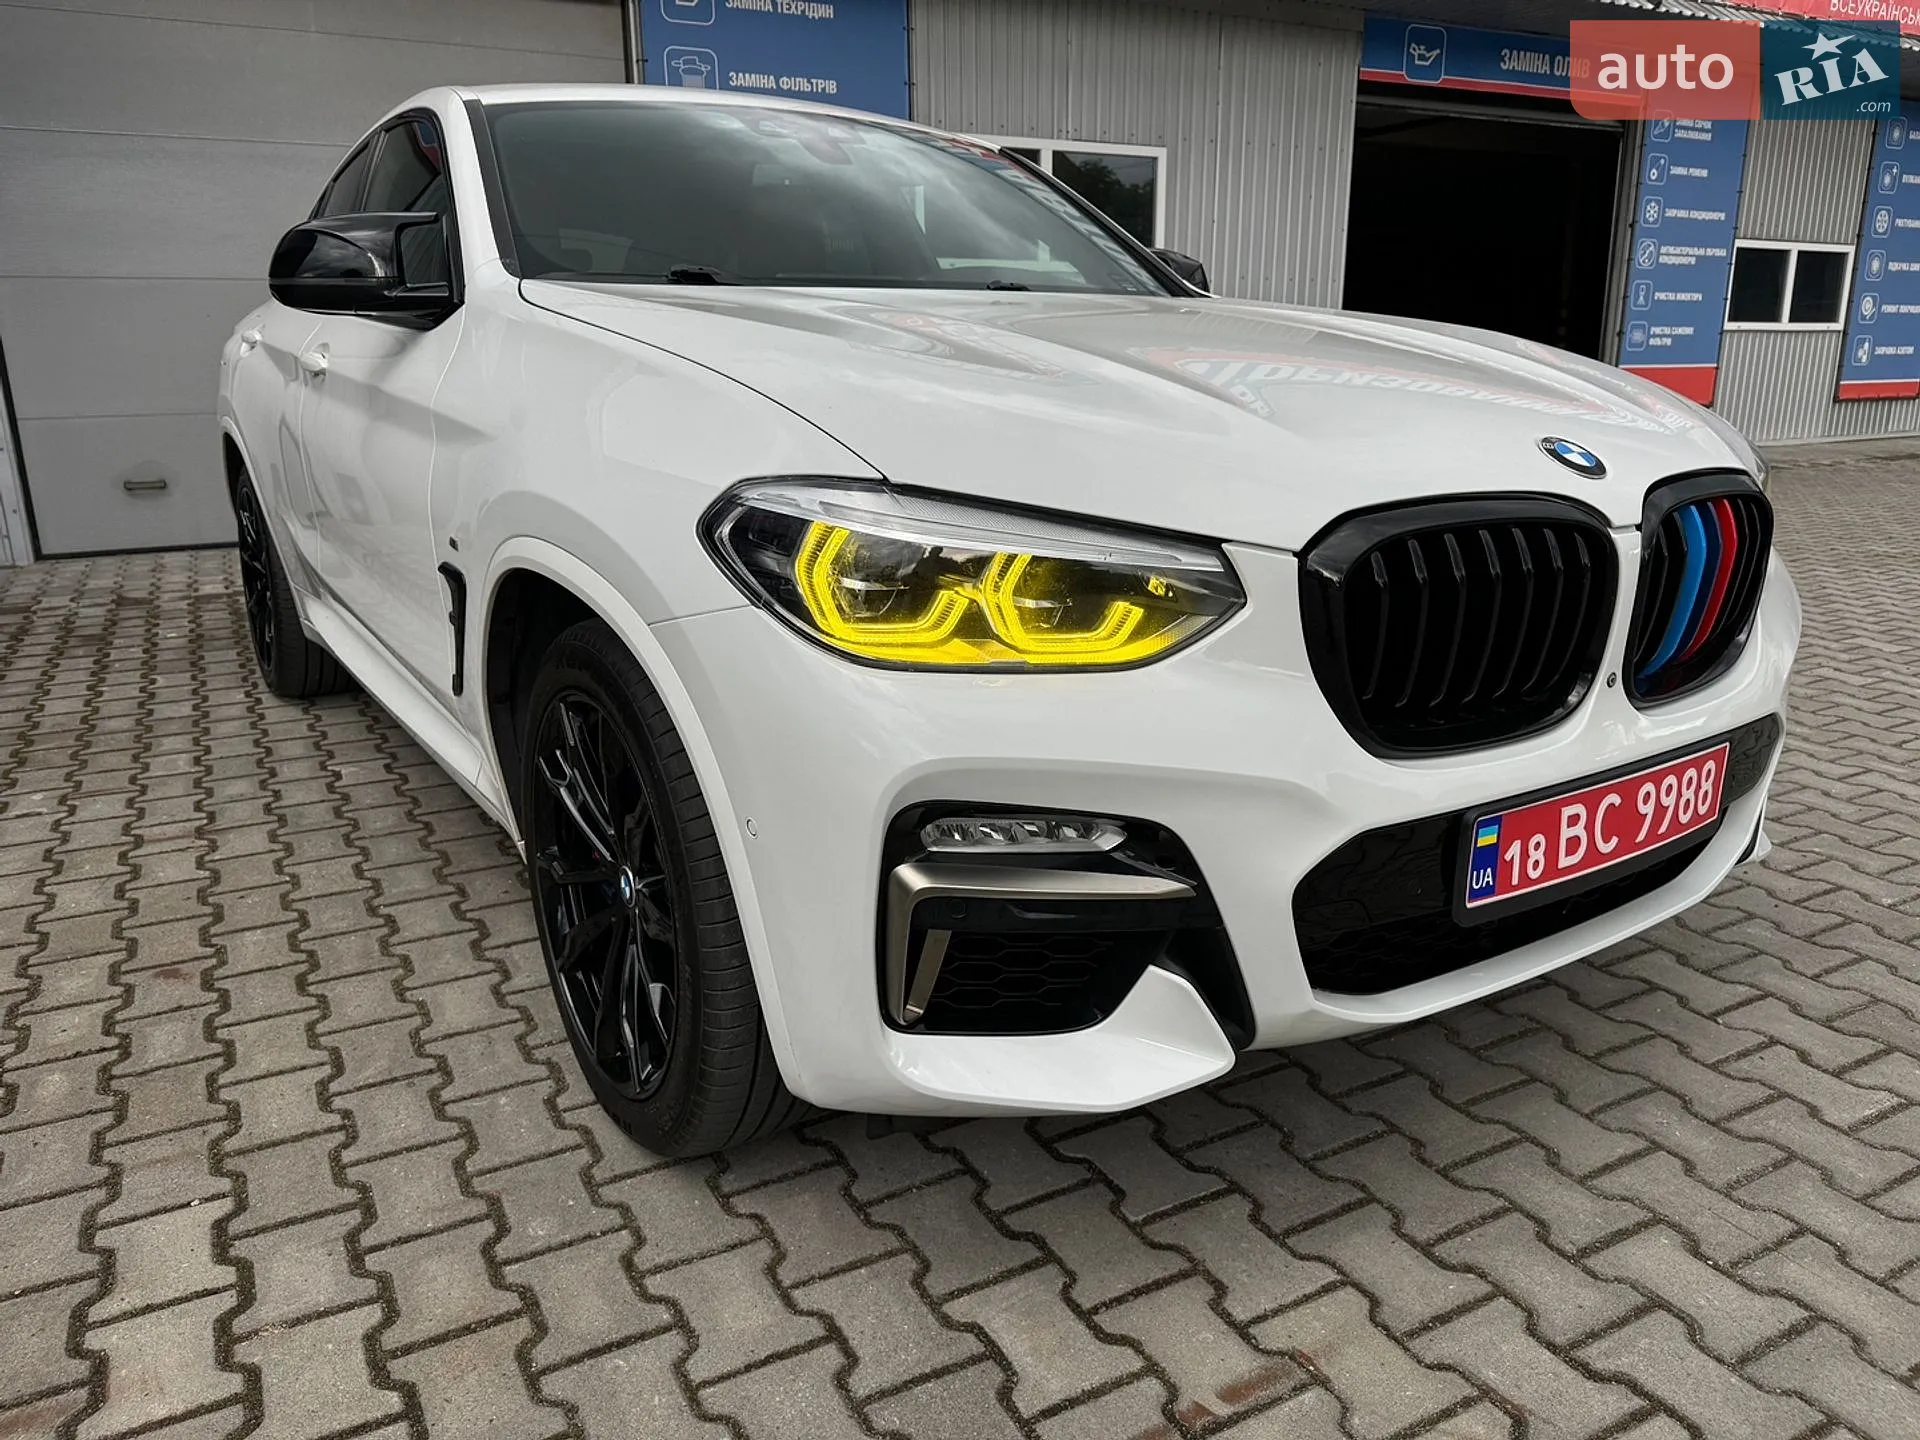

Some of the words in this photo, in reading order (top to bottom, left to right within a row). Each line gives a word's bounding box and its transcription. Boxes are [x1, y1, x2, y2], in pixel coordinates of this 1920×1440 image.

[774, 0, 834, 20] ТЕХРІДИН
[1500, 48, 1550, 75] ЗАМІНА
[1553, 56, 1590, 78] ОЛИВ
[728, 71, 776, 90] ЗАМІНА
[779, 76, 837, 95] ФІЛЬТРІВ
[1504, 833, 1546, 886] 18
[1557, 793, 1622, 869] BC
[1635, 759, 1716, 843] 9988
[1472, 867, 1494, 890] UA
